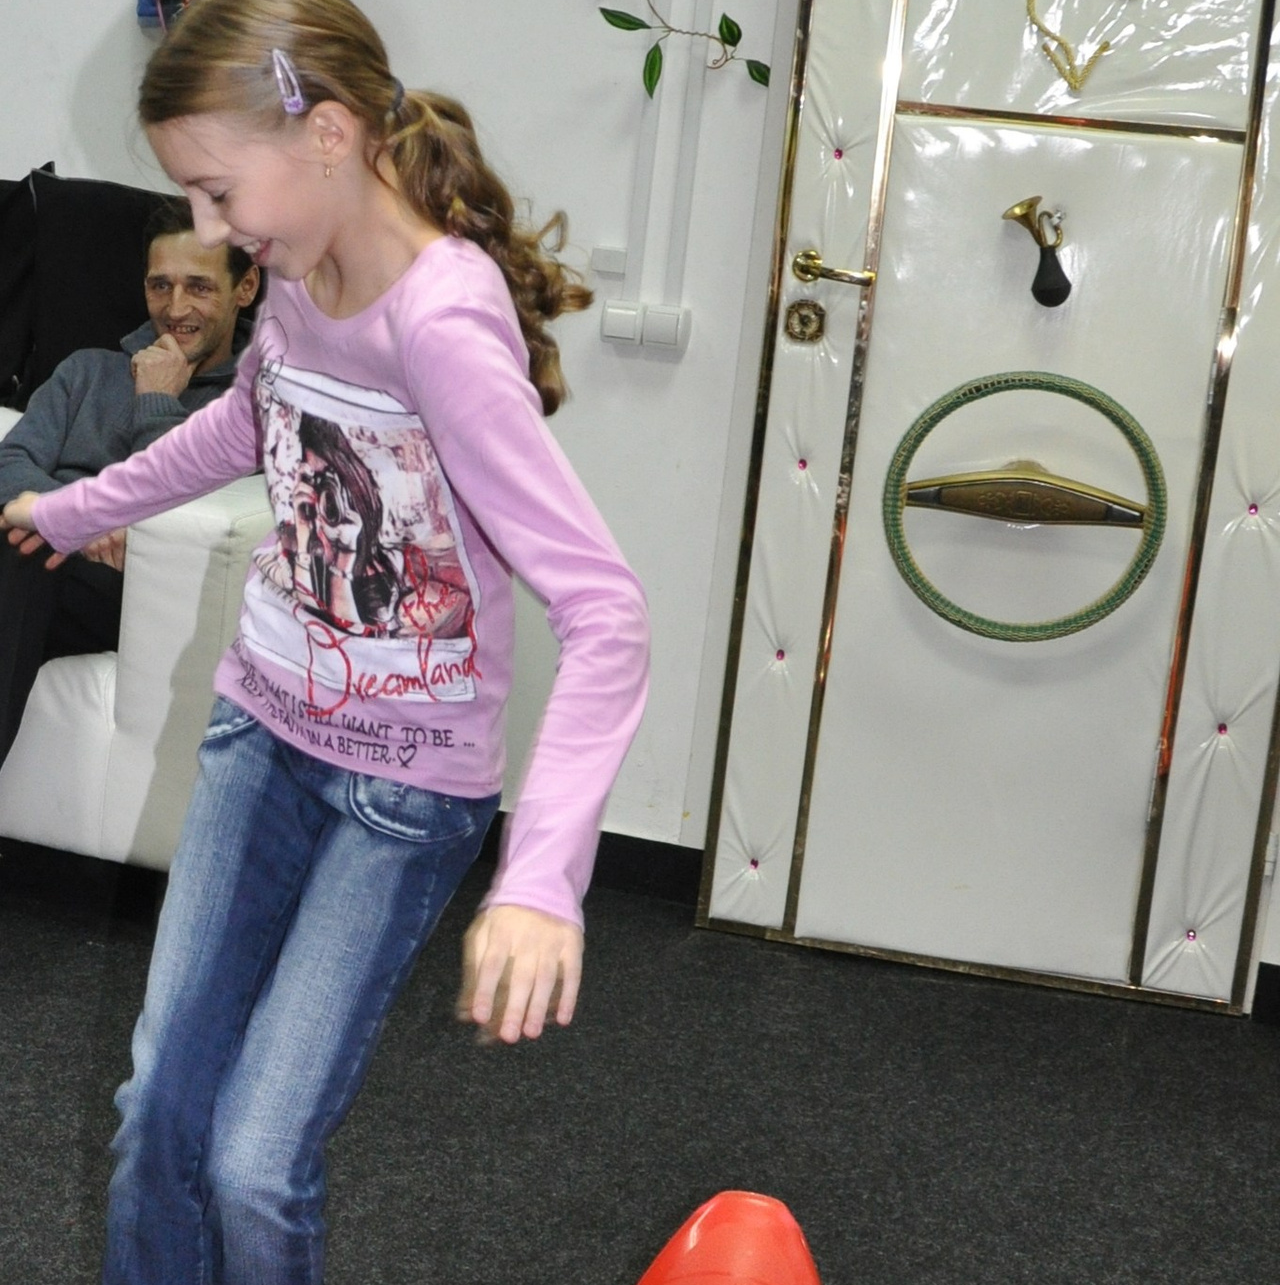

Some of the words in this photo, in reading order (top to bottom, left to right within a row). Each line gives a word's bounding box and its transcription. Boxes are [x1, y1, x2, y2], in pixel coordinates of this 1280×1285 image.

[341, 713, 393, 740] WANT
[401, 726, 427, 745] TO
[431, 728, 455, 748] BE
